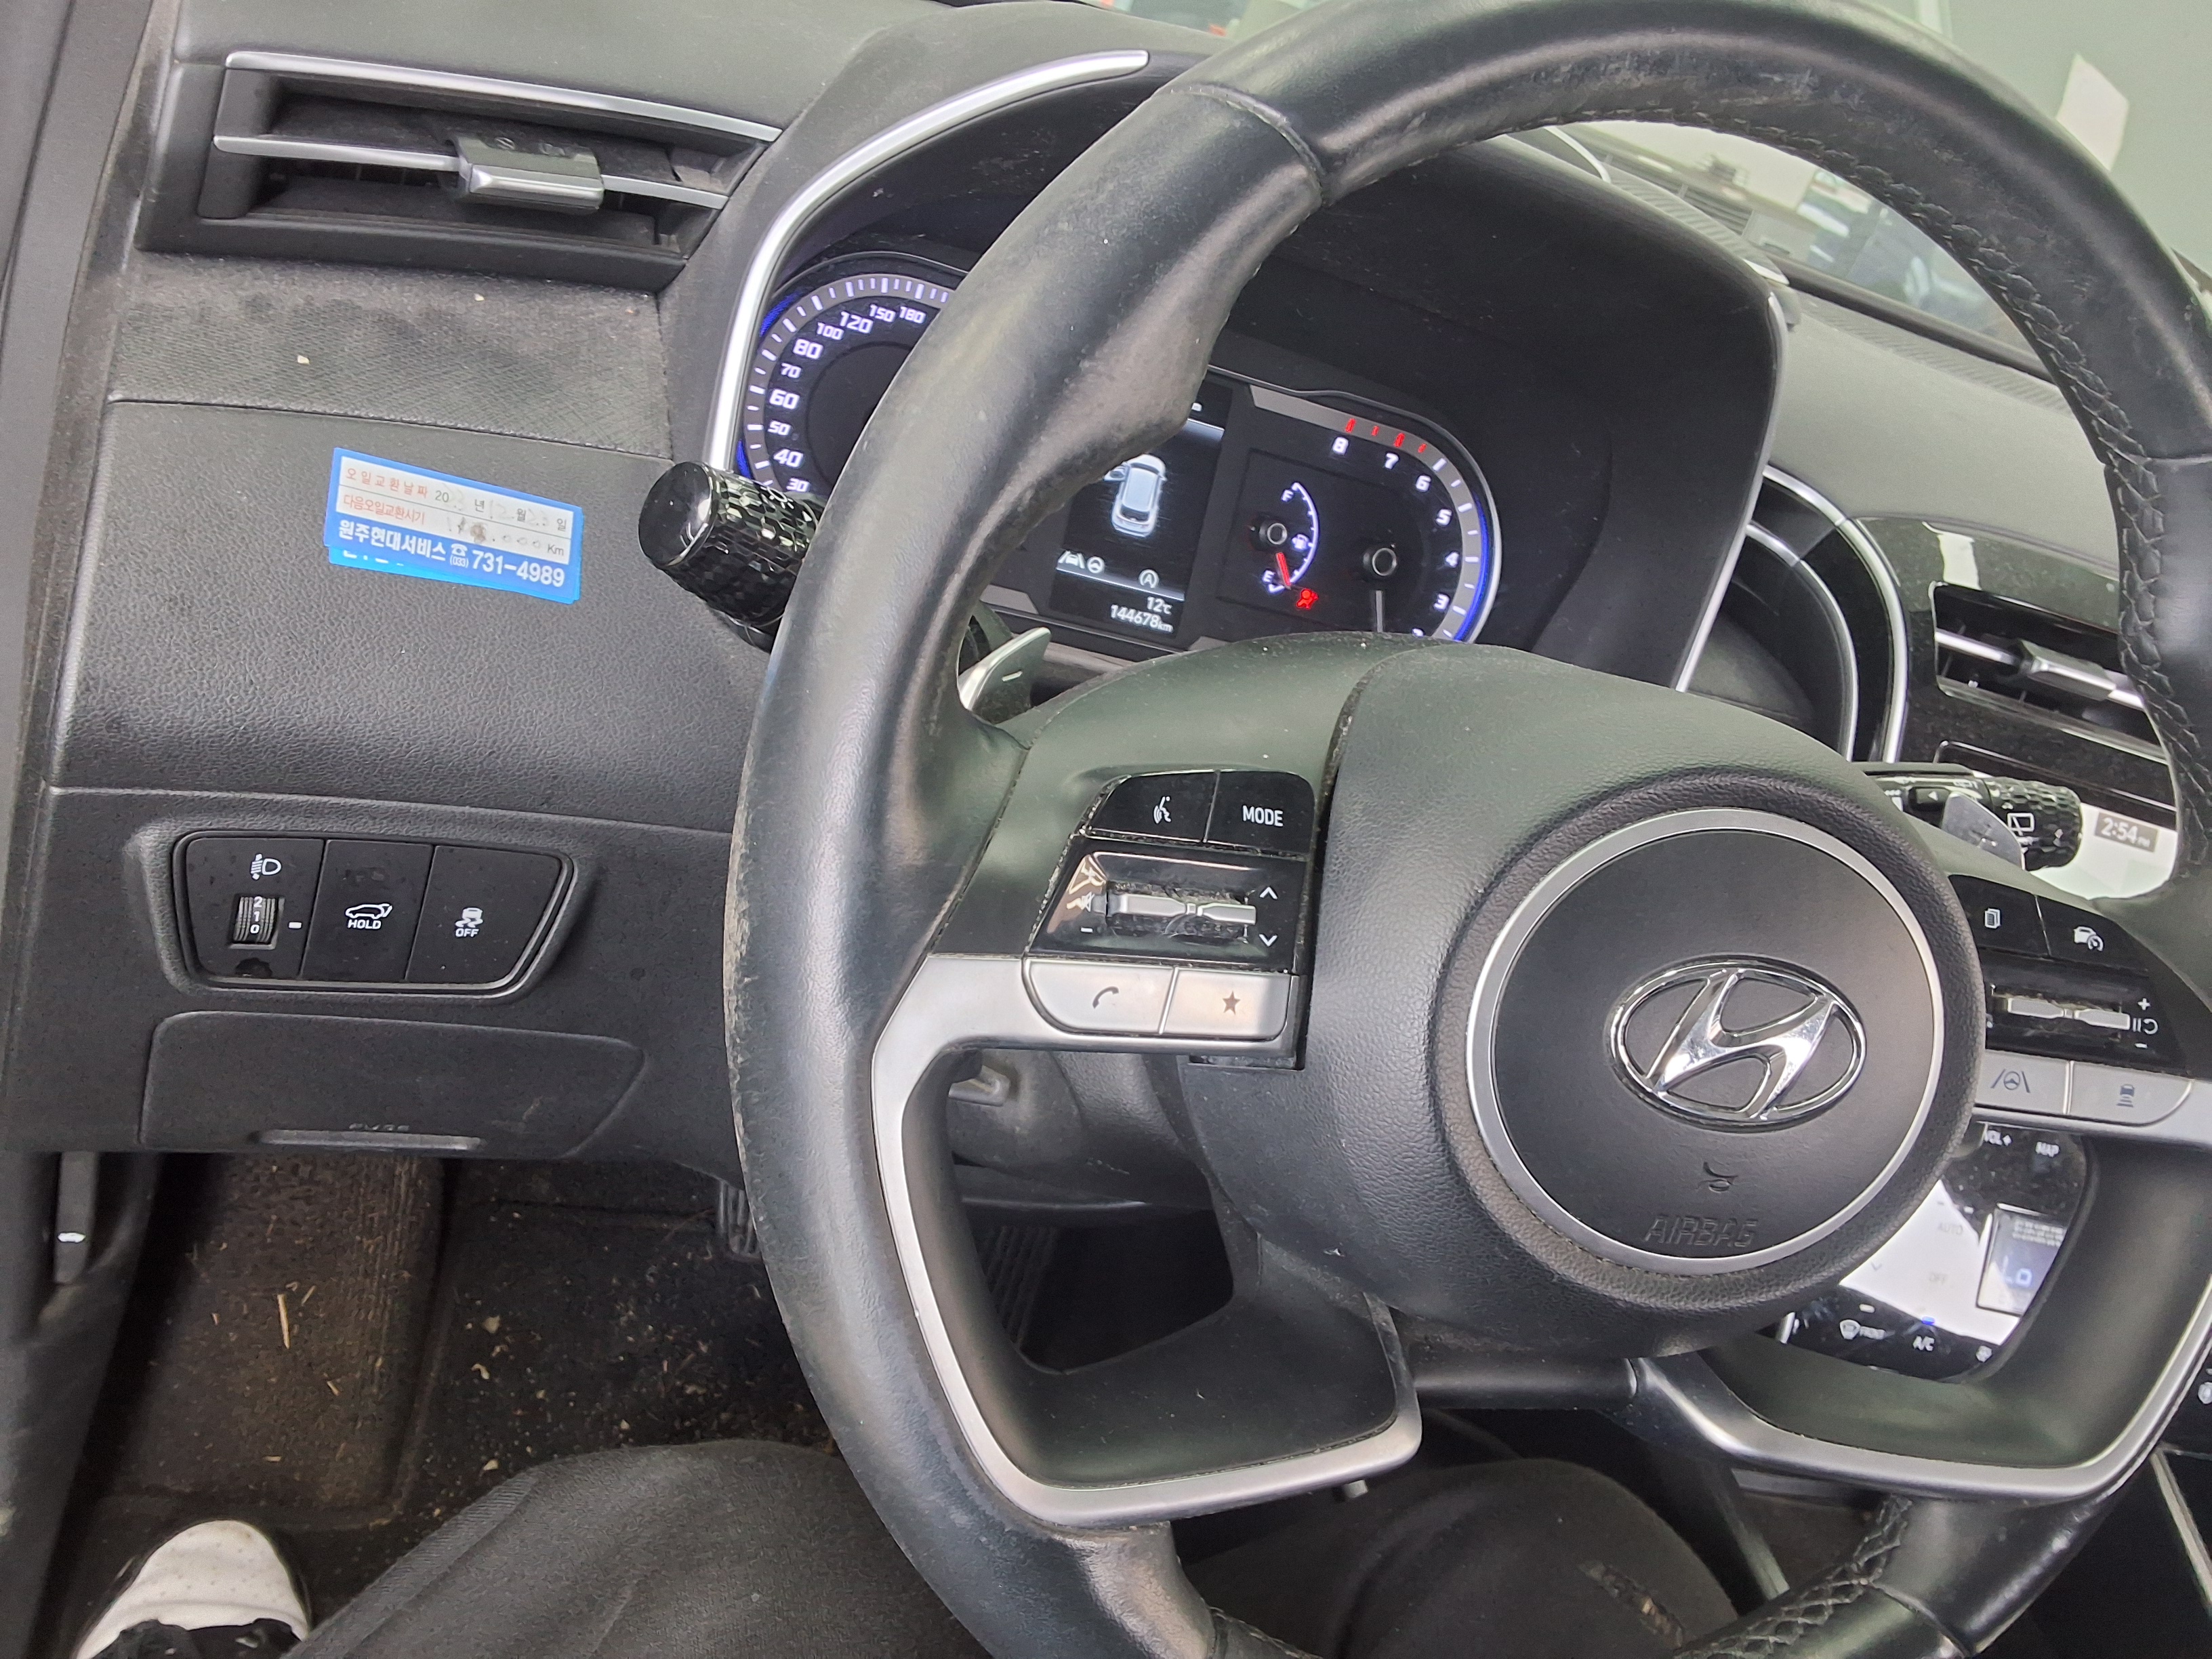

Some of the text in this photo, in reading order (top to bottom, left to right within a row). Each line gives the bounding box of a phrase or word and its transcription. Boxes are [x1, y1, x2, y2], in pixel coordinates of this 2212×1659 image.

[869, 304, 896, 323] 150
[899, 306, 926, 324] 180
[840, 311, 874, 334] 120
[817, 322, 844, 340] 100
[793, 339, 823, 359] 80
[781, 363, 801, 379] 70
[769, 388, 800, 409] 60
[768, 420, 791, 436] 50
[1332, 437, 1349, 455] 8
[773, 449, 804, 468] 40
[1385, 453, 1399, 469] 7
[786, 477, 810, 492] 30
[1416, 475, 1431, 492] 6
[435, 490, 449, 503] 20
[1281, 489, 1294, 502] F
[475, 499, 485, 513] 년
[556, 518, 567, 532] 일
[1436, 509, 1452, 526] 5
[339, 519, 447, 562] 원주현대서비스
[472, 549, 565, 588] 731-4989
[547, 544, 564, 556] Km
[1445, 552, 1458, 568] 4
[1262, 569, 1275, 583] E
[1433, 594, 1450, 610] 3
[1242, 805, 1284, 827] MODE
[2102, 817, 2137, 844] 2:54
[253, 896, 263, 908] 2
[253, 911, 260, 922] 1
[348, 919, 382, 930] HOLD
[250, 924, 260, 934] 0
[455, 928, 479, 937] OFF
[1643, 1214, 1759, 1248] AIRBAG
